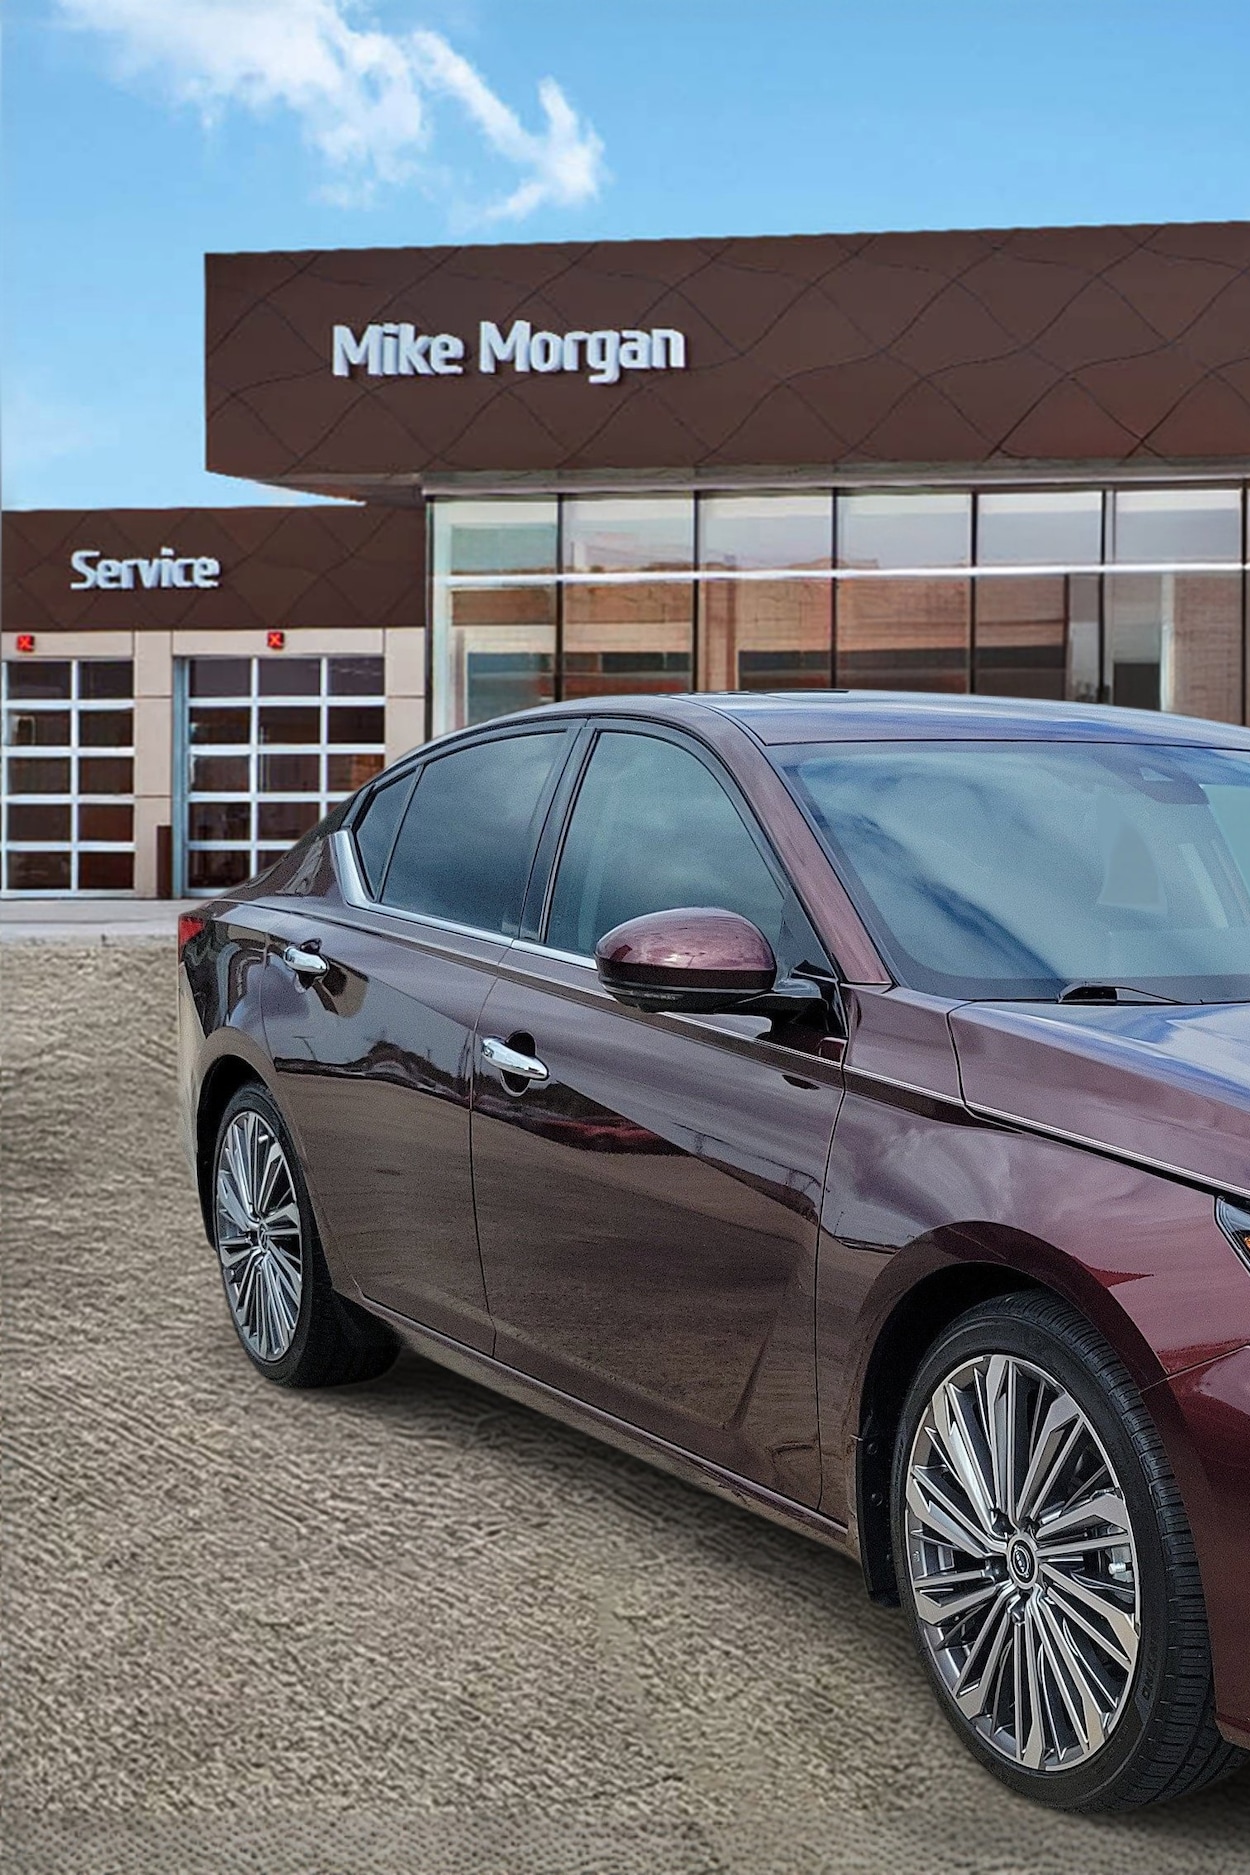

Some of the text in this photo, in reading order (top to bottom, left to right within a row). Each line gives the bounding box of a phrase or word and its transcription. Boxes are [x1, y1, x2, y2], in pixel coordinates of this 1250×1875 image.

[332, 320, 686, 384] Mike Morgan
[70, 547, 220, 590] Service
